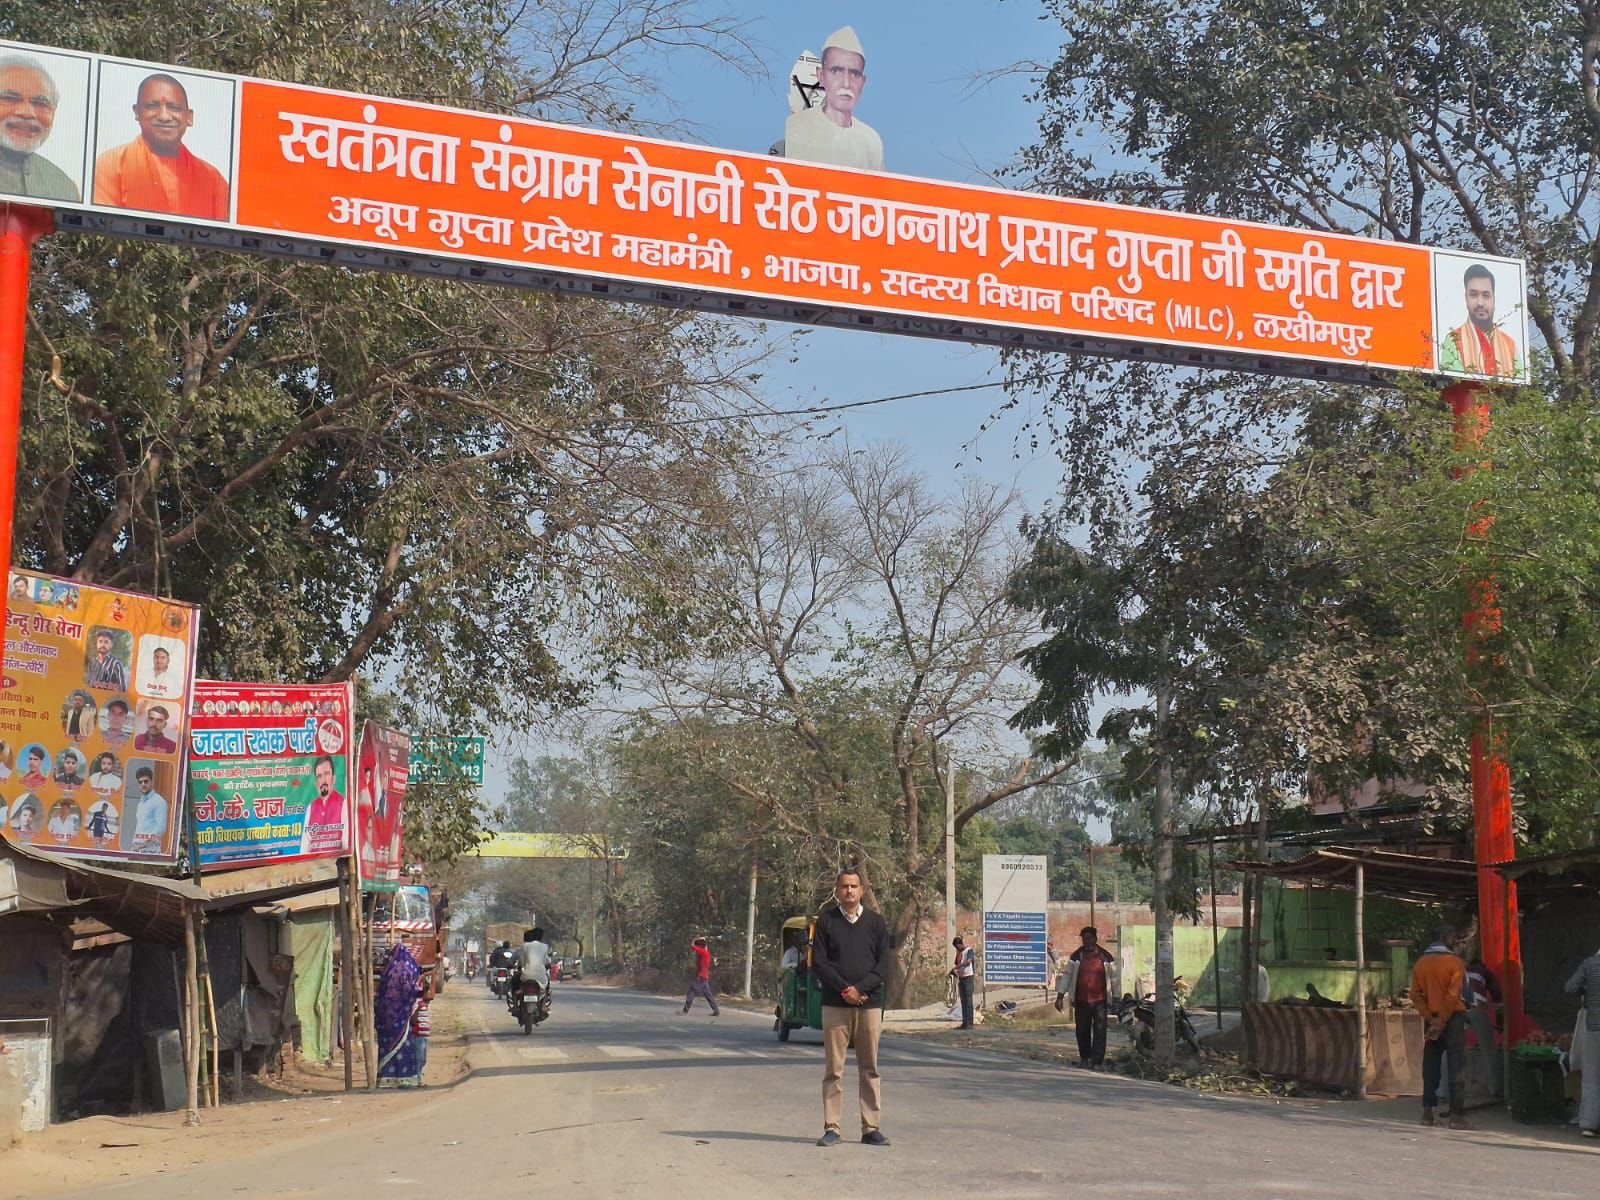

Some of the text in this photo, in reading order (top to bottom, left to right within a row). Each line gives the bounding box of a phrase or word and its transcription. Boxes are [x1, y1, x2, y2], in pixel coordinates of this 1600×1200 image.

[279, 107, 1406, 310] स्वतंत्रता संग्राम सेनानी सेठ जगन्नाथ प्रसाद गुप्ता जी स्मृति द्वार
[327, 195, 420, 239] अनूप
[427, 208, 515, 247] गुप्ता
[521, 215, 604, 258] प्रदेश
[764, 254, 872, 295] भाजपा,
[880, 268, 971, 304] सदस्य
[976, 272, 1063, 315] विधान
[1069, 285, 1156, 325] परिषद
[1165, 298, 1244, 342] (MLC),
[1252, 310, 1374, 357] लखीमपुर
[33, 612, 53, 633] शेर
[56, 615, 83, 640] सेना
[191, 716, 318, 756] जनता रक्षक पार्टी
[254, 797, 284, 820] राज
